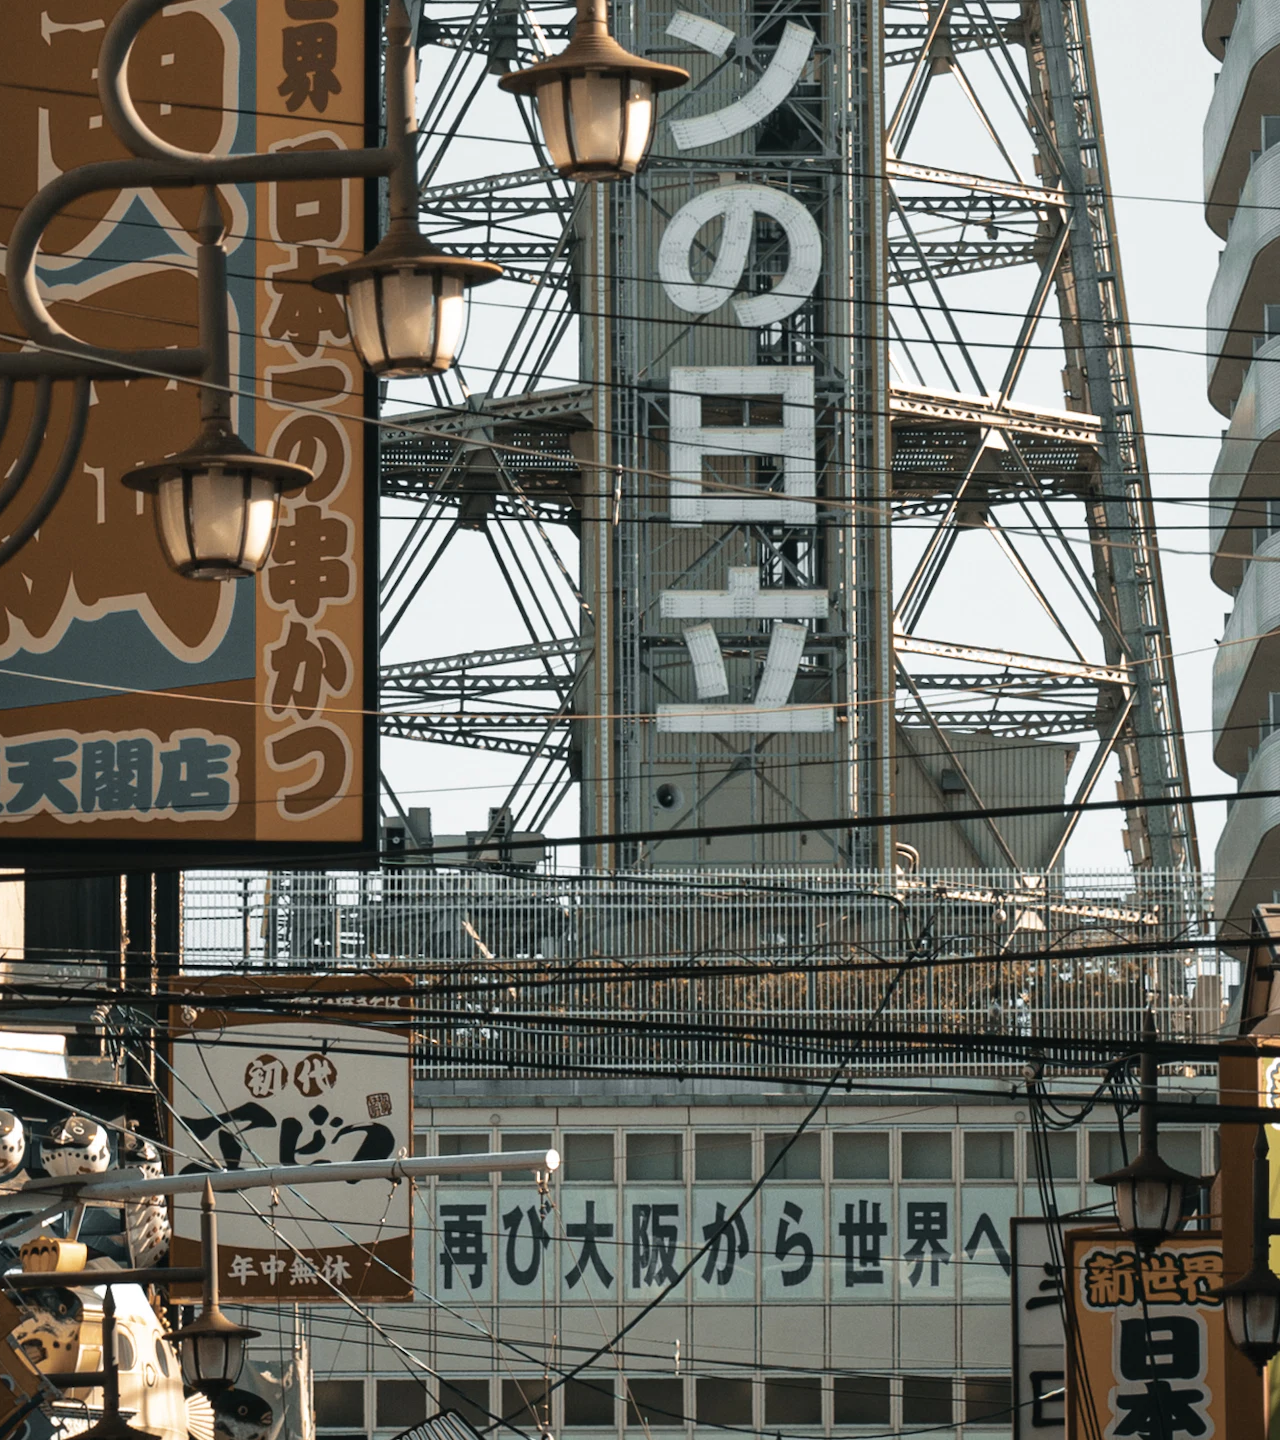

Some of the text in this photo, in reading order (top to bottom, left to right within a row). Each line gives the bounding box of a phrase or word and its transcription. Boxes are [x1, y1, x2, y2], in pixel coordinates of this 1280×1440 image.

[227, 1253, 354, 1287] 年中無休
[438, 1199, 1012, 1290] 再び大阪から世界へ
[1086, 1250, 1223, 1306] 新世界
